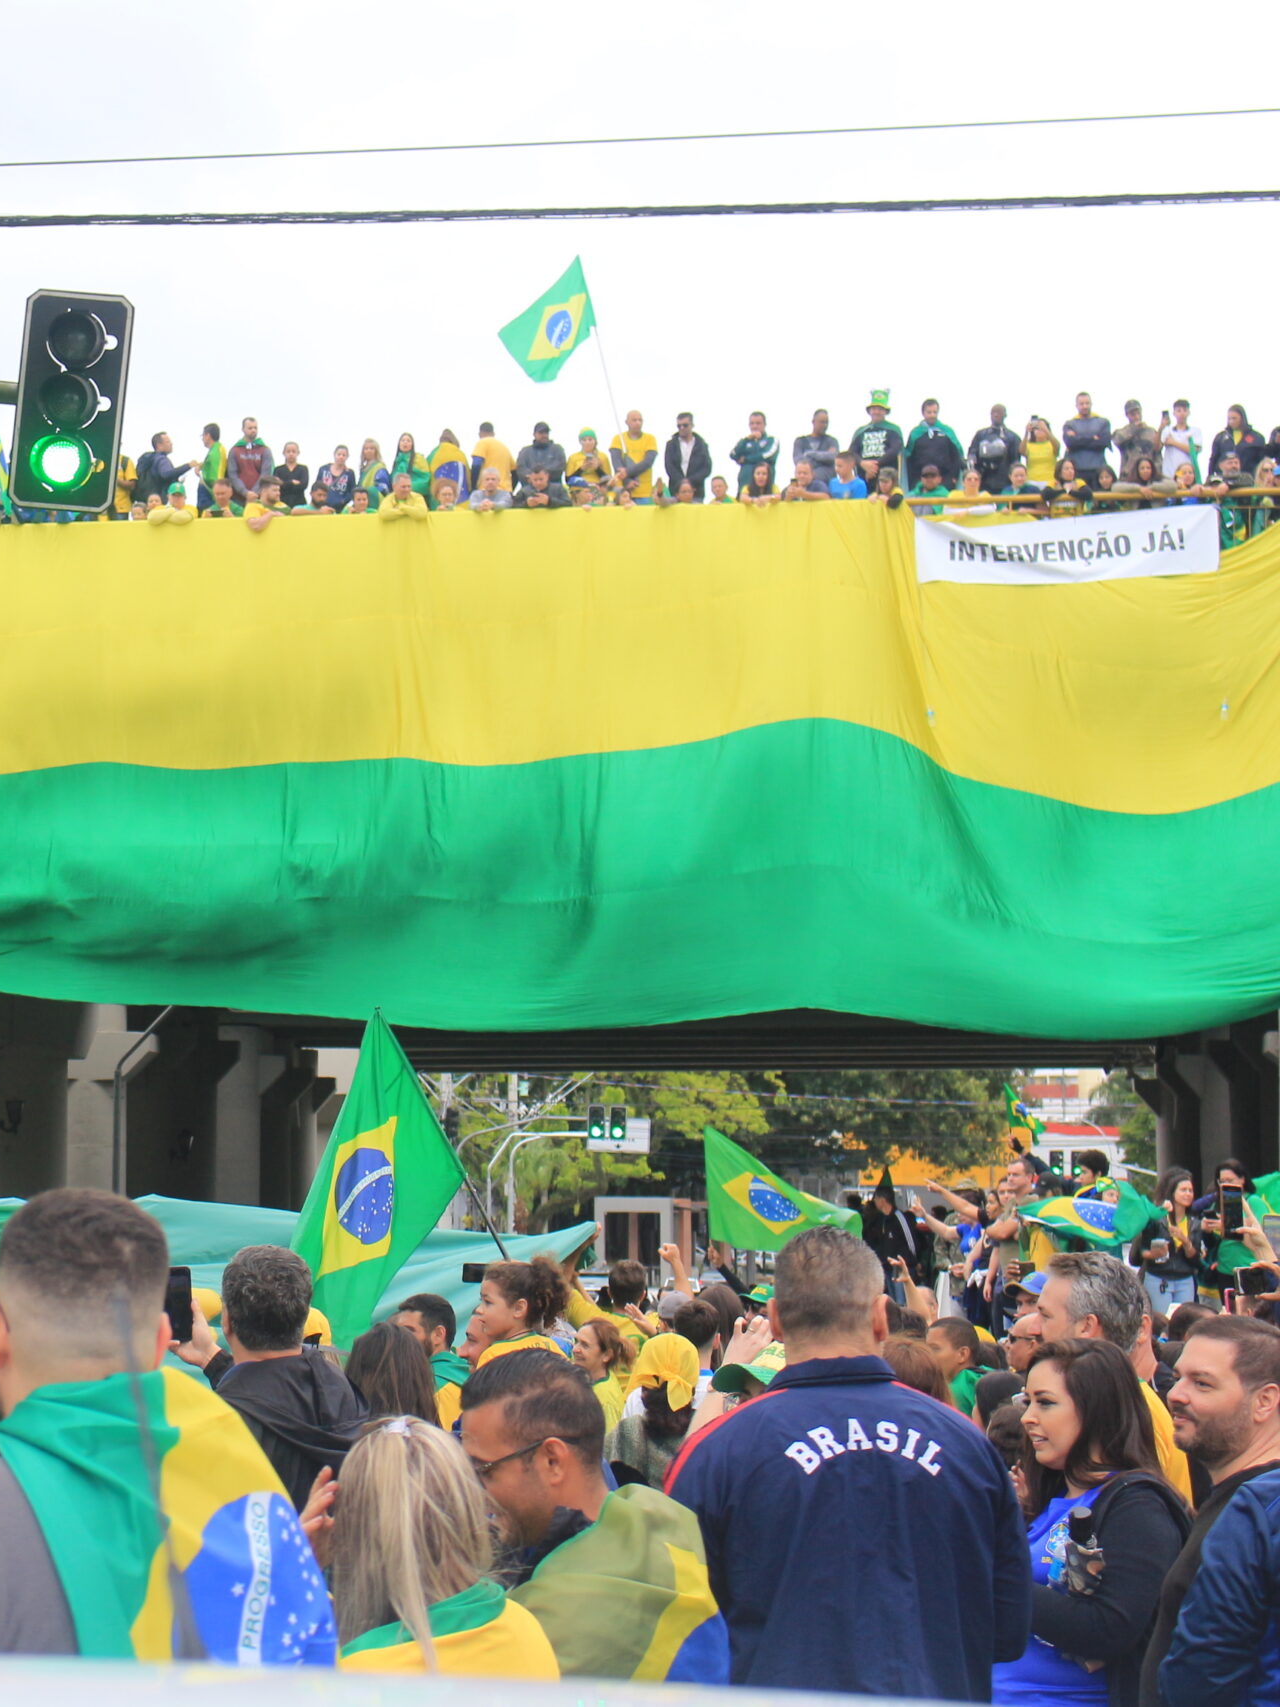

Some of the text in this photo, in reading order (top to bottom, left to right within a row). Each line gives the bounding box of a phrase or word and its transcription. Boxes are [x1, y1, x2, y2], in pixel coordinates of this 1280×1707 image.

[949, 523, 1185, 565] INTERVENÇÃO JÁ!
[784, 1418, 942, 1476] BRASIL
[241, 1501, 269, 1650] PROGRESSO
